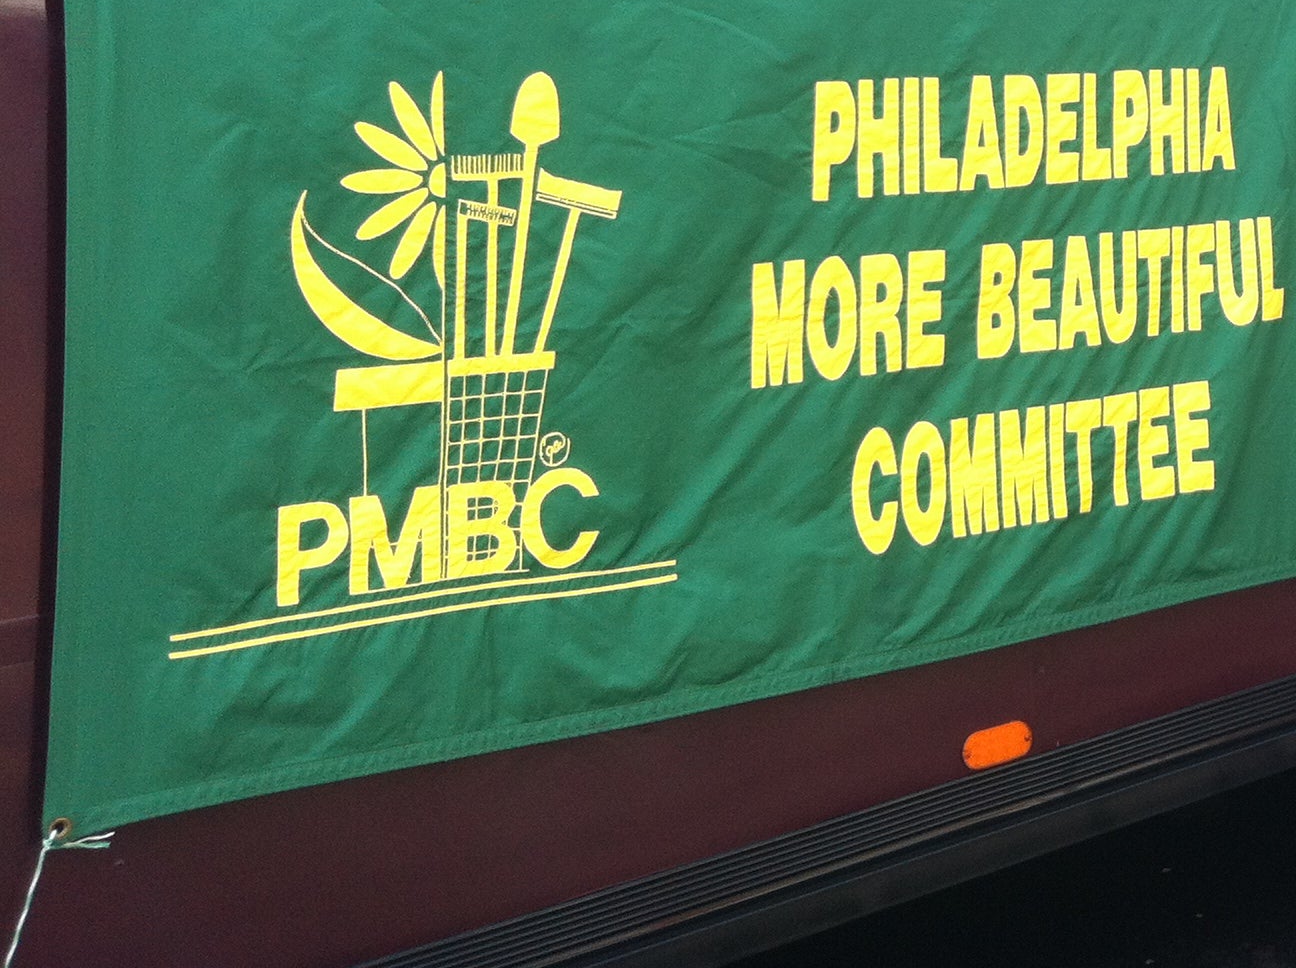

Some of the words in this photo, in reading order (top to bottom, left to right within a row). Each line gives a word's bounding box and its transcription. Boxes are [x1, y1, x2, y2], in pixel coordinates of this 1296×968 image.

[811, 65, 1236, 202] PHILADELPHIA
[750, 248, 946, 389] MORE
[975, 216, 1285, 359] BEAUTIFUL
[275, 467, 601, 608] PMBC
[850, 380, 1215, 555] COMMITTEE
